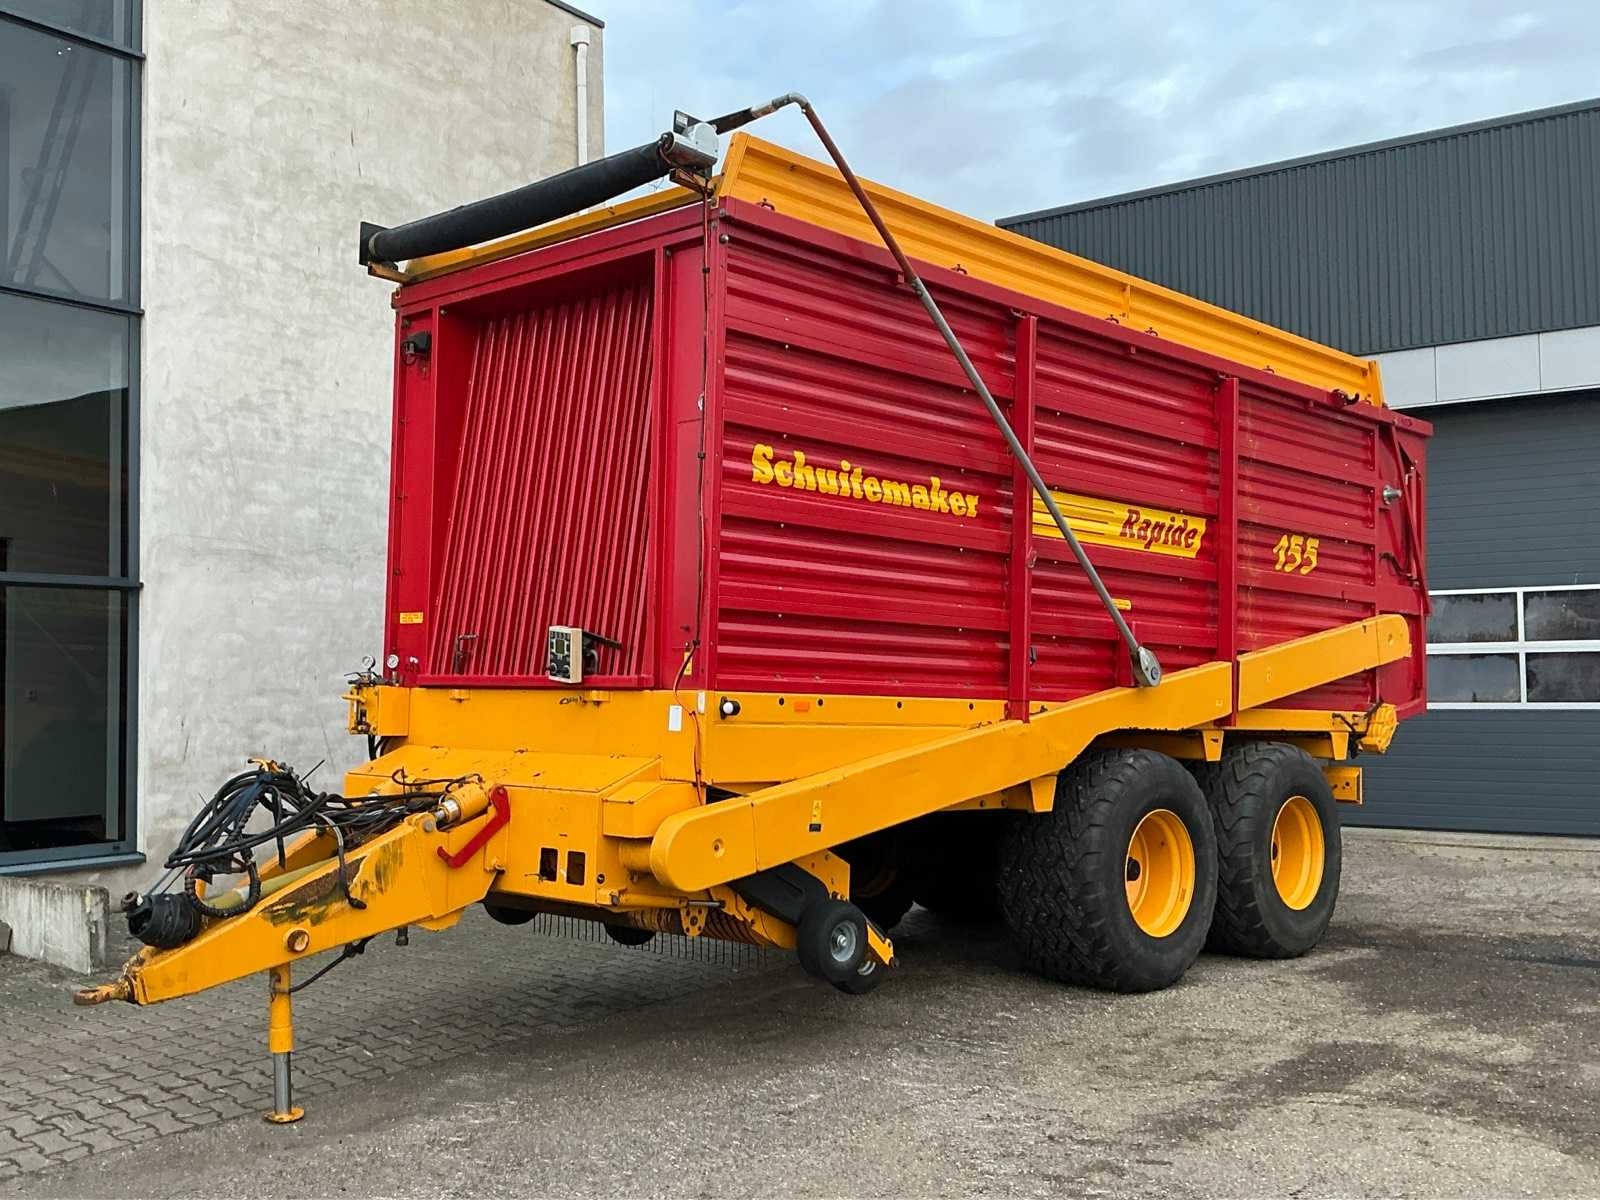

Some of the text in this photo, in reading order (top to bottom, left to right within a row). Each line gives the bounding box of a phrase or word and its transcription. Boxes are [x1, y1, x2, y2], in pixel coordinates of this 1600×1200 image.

[751, 443, 979, 518] Schuitemaker
[1119, 508, 1200, 550] Rapide
[1272, 534, 1320, 576] 155
